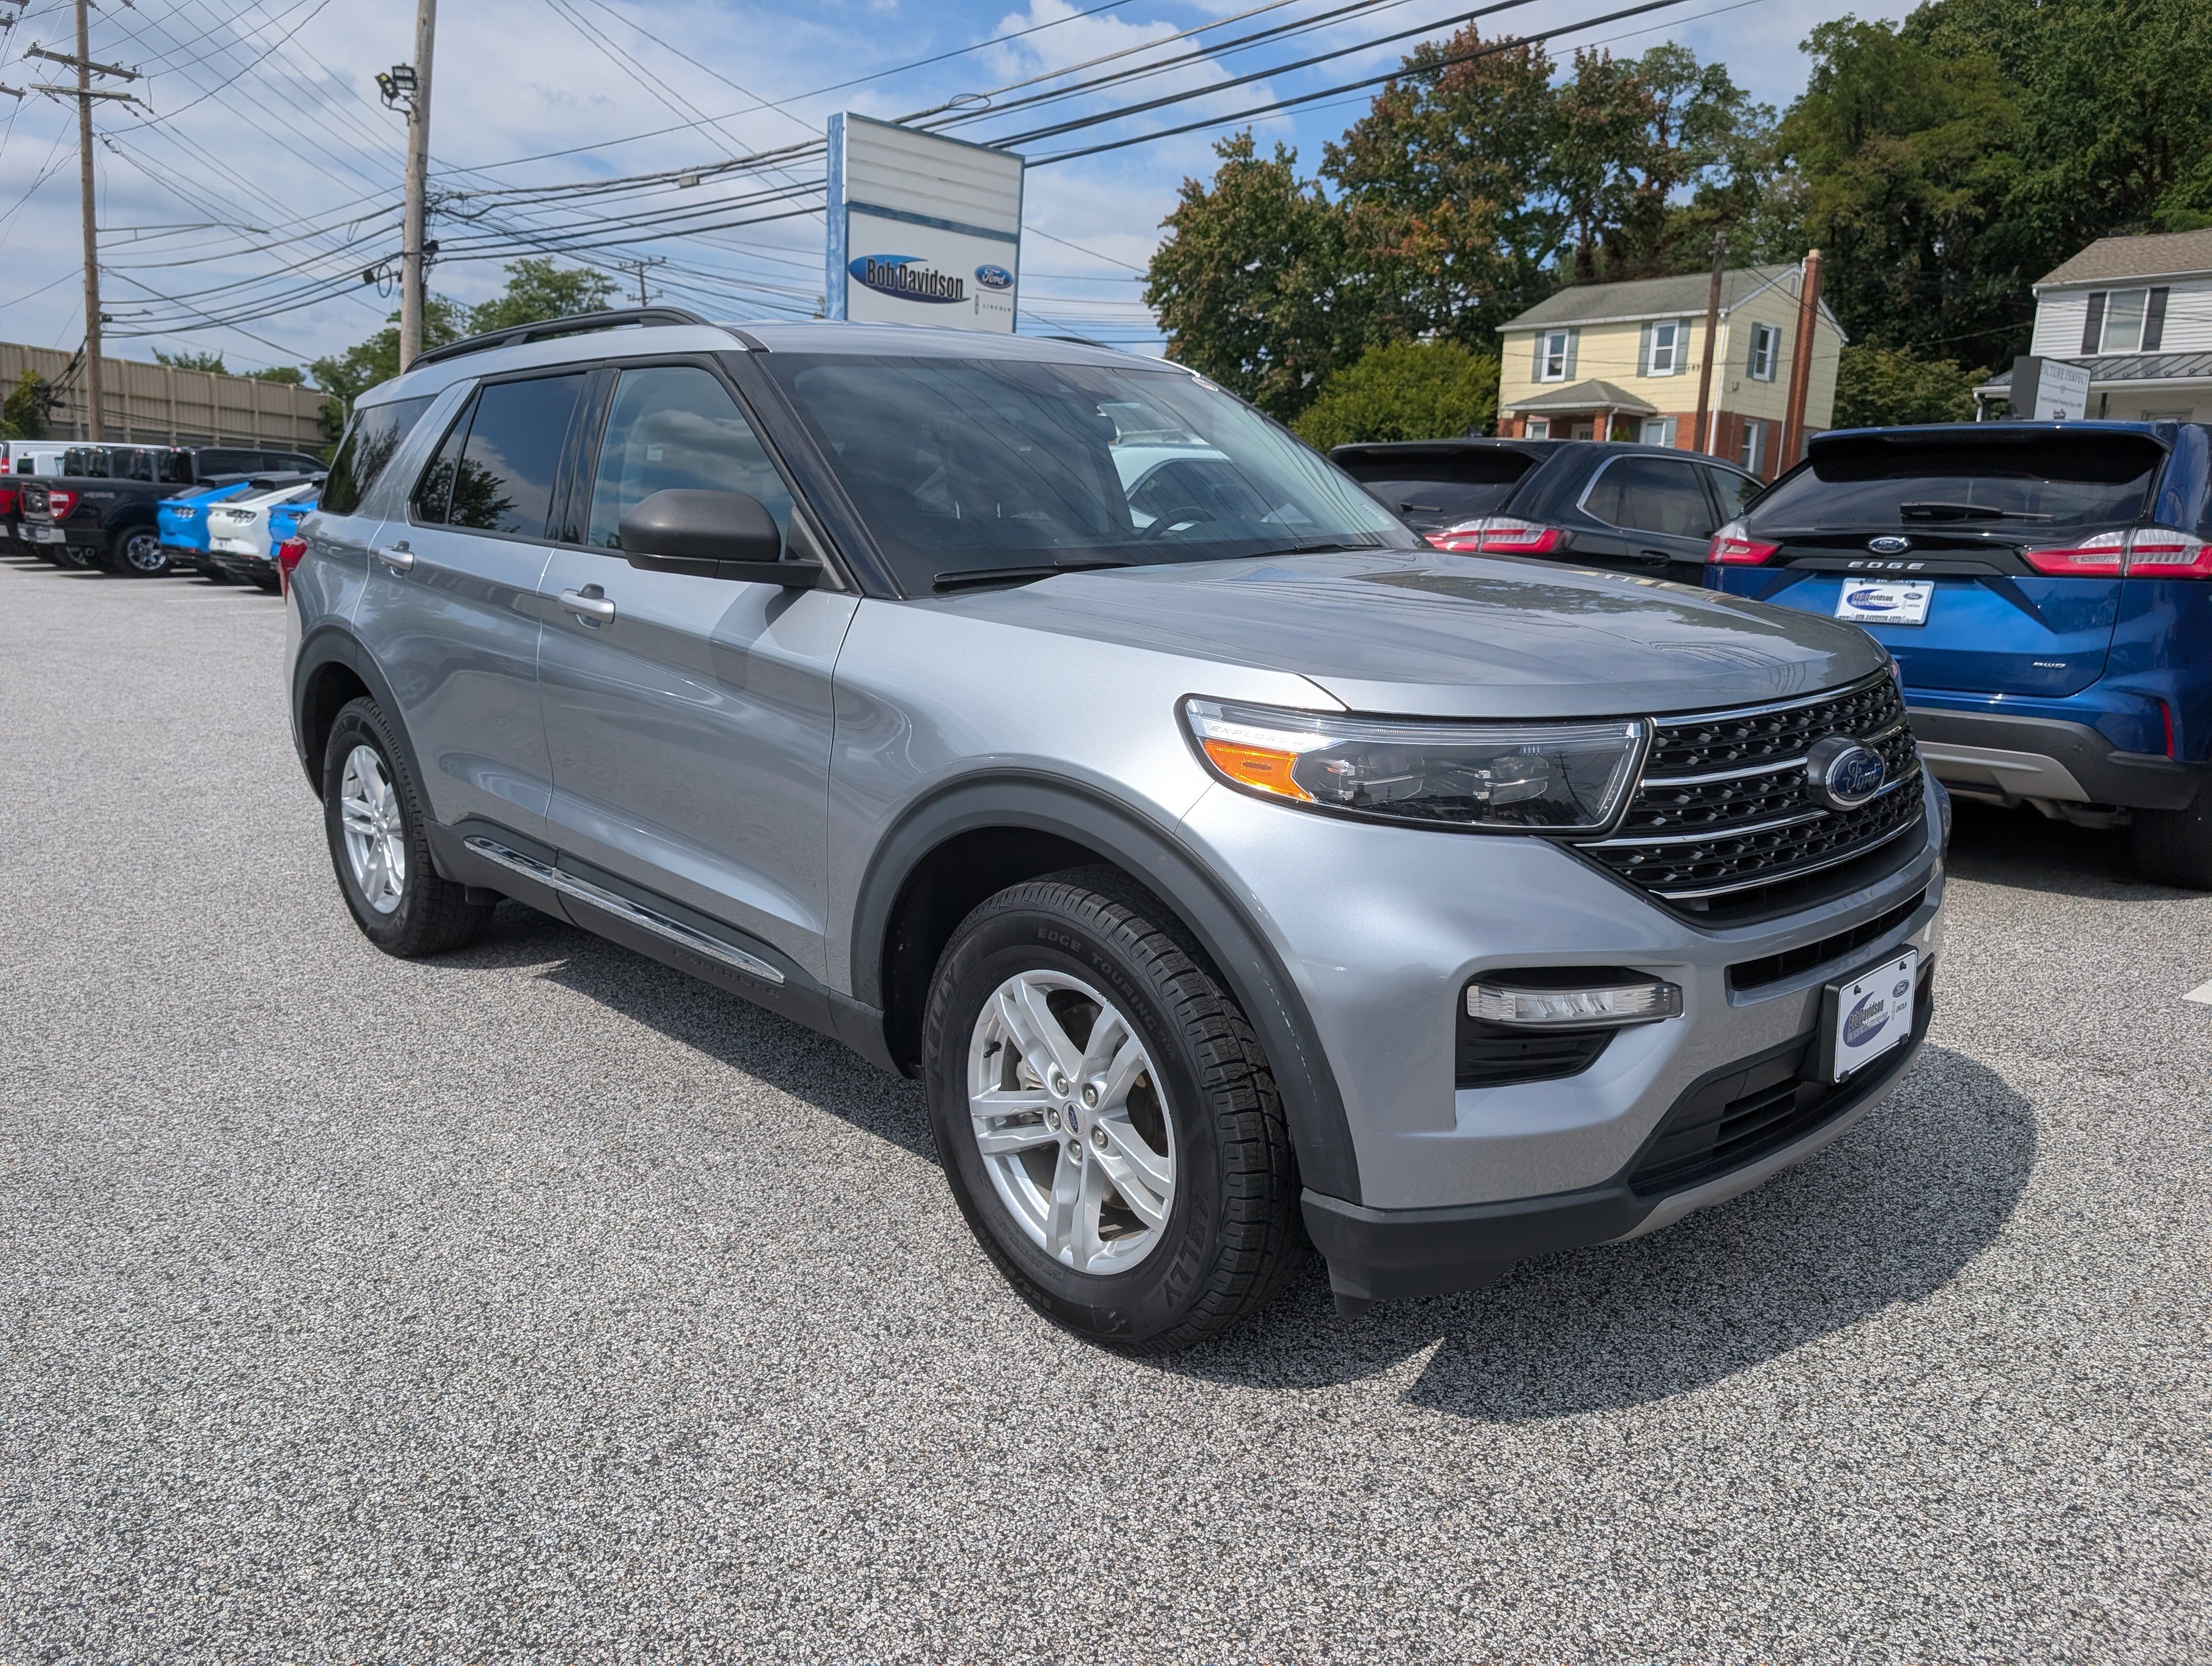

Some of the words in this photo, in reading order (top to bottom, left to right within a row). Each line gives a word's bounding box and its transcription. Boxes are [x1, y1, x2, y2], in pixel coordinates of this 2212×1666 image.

[867, 258, 894, 287] Bob
[898, 264, 964, 299] Davidson
[982, 268, 1007, 286] Ford
[982, 304, 1012, 312] LINCOLN
[1877, 540, 1899, 549] Ford
[1848, 561, 1925, 569] EDGE
[1866, 593, 1893, 601] Davidson
[1842, 759, 1881, 793] Ford
[1038, 927, 1083, 953] EDGE
[1092, 952, 1158, 1030] TOURING
[927, 961, 960, 1080] KELLY
[1849, 1012, 1860, 1029] Bob
[1860, 999, 1885, 1022] Davidson
[1163, 1190, 1209, 1308] KELLY
